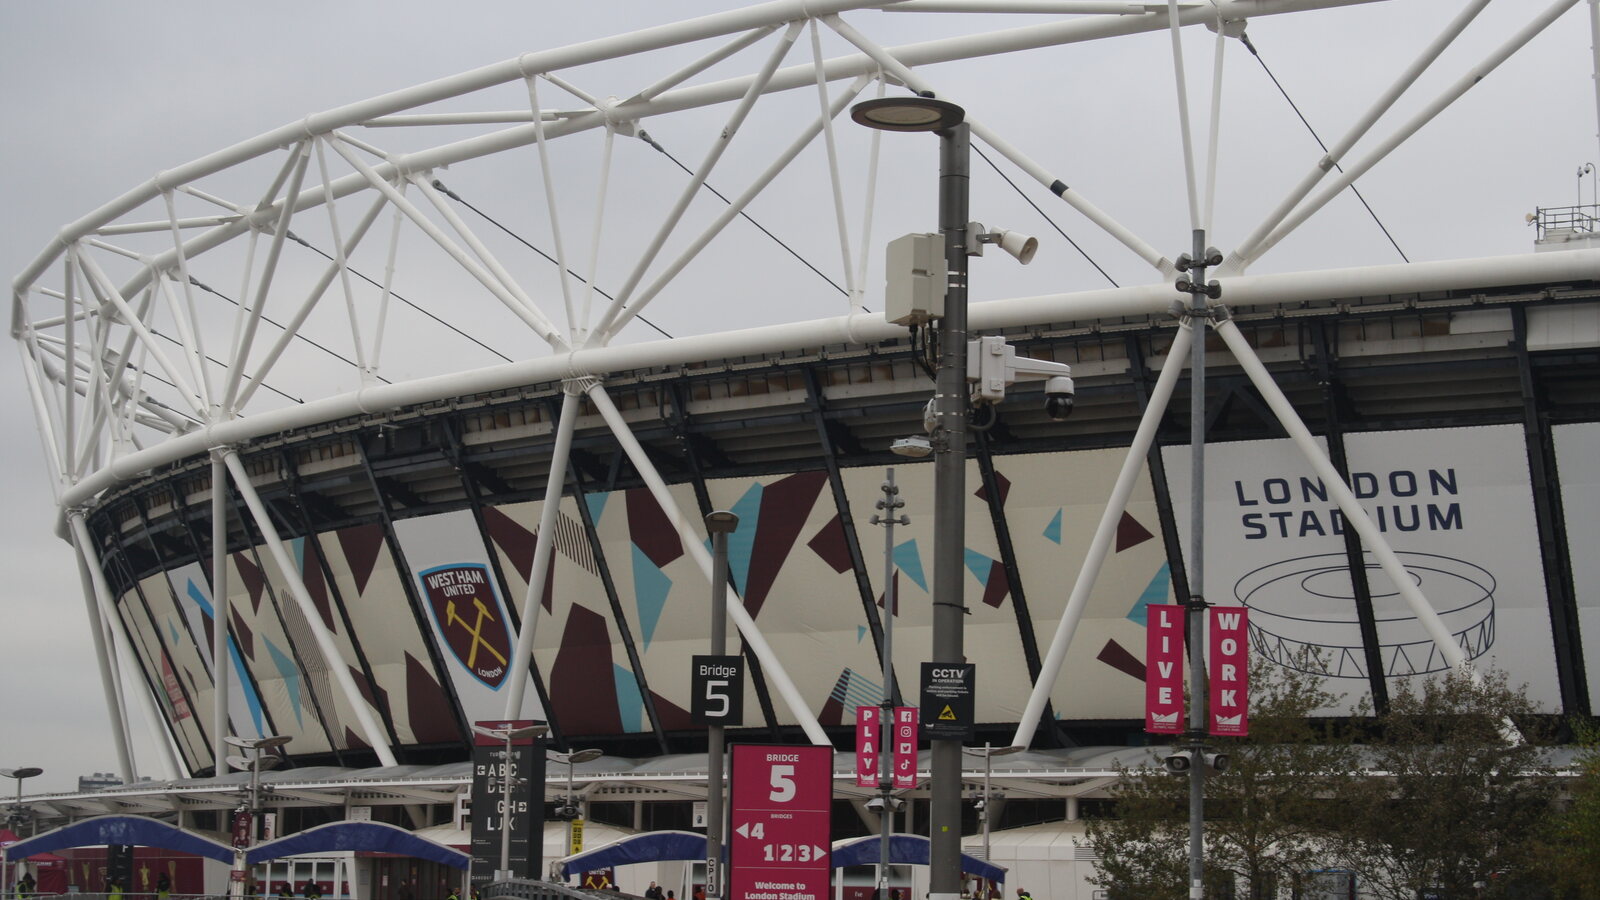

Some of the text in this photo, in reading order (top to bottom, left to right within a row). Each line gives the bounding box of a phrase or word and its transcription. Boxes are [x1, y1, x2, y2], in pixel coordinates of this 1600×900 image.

[1235, 468, 1458, 506] LONDON
[427, 570, 484, 589] WEST HAM
[442, 584, 475, 597] UNITED
[1157, 610, 1173, 704] LIVE
[1218, 613, 1240, 707] WORK
[478, 666, 503, 678] LONDON
[700, 664, 736, 678] Bridge
[932, 668, 964, 678] CCTV
[705, 680, 729, 717] 5
[863, 710, 873, 769] PLAY
[766, 754, 799, 762] BRIDGE
[769, 765, 796, 802] 5
[750, 822, 764, 839] 4
[755, 882, 806, 890] Welcome to
[745, 892, 815, 900] London Stadium
